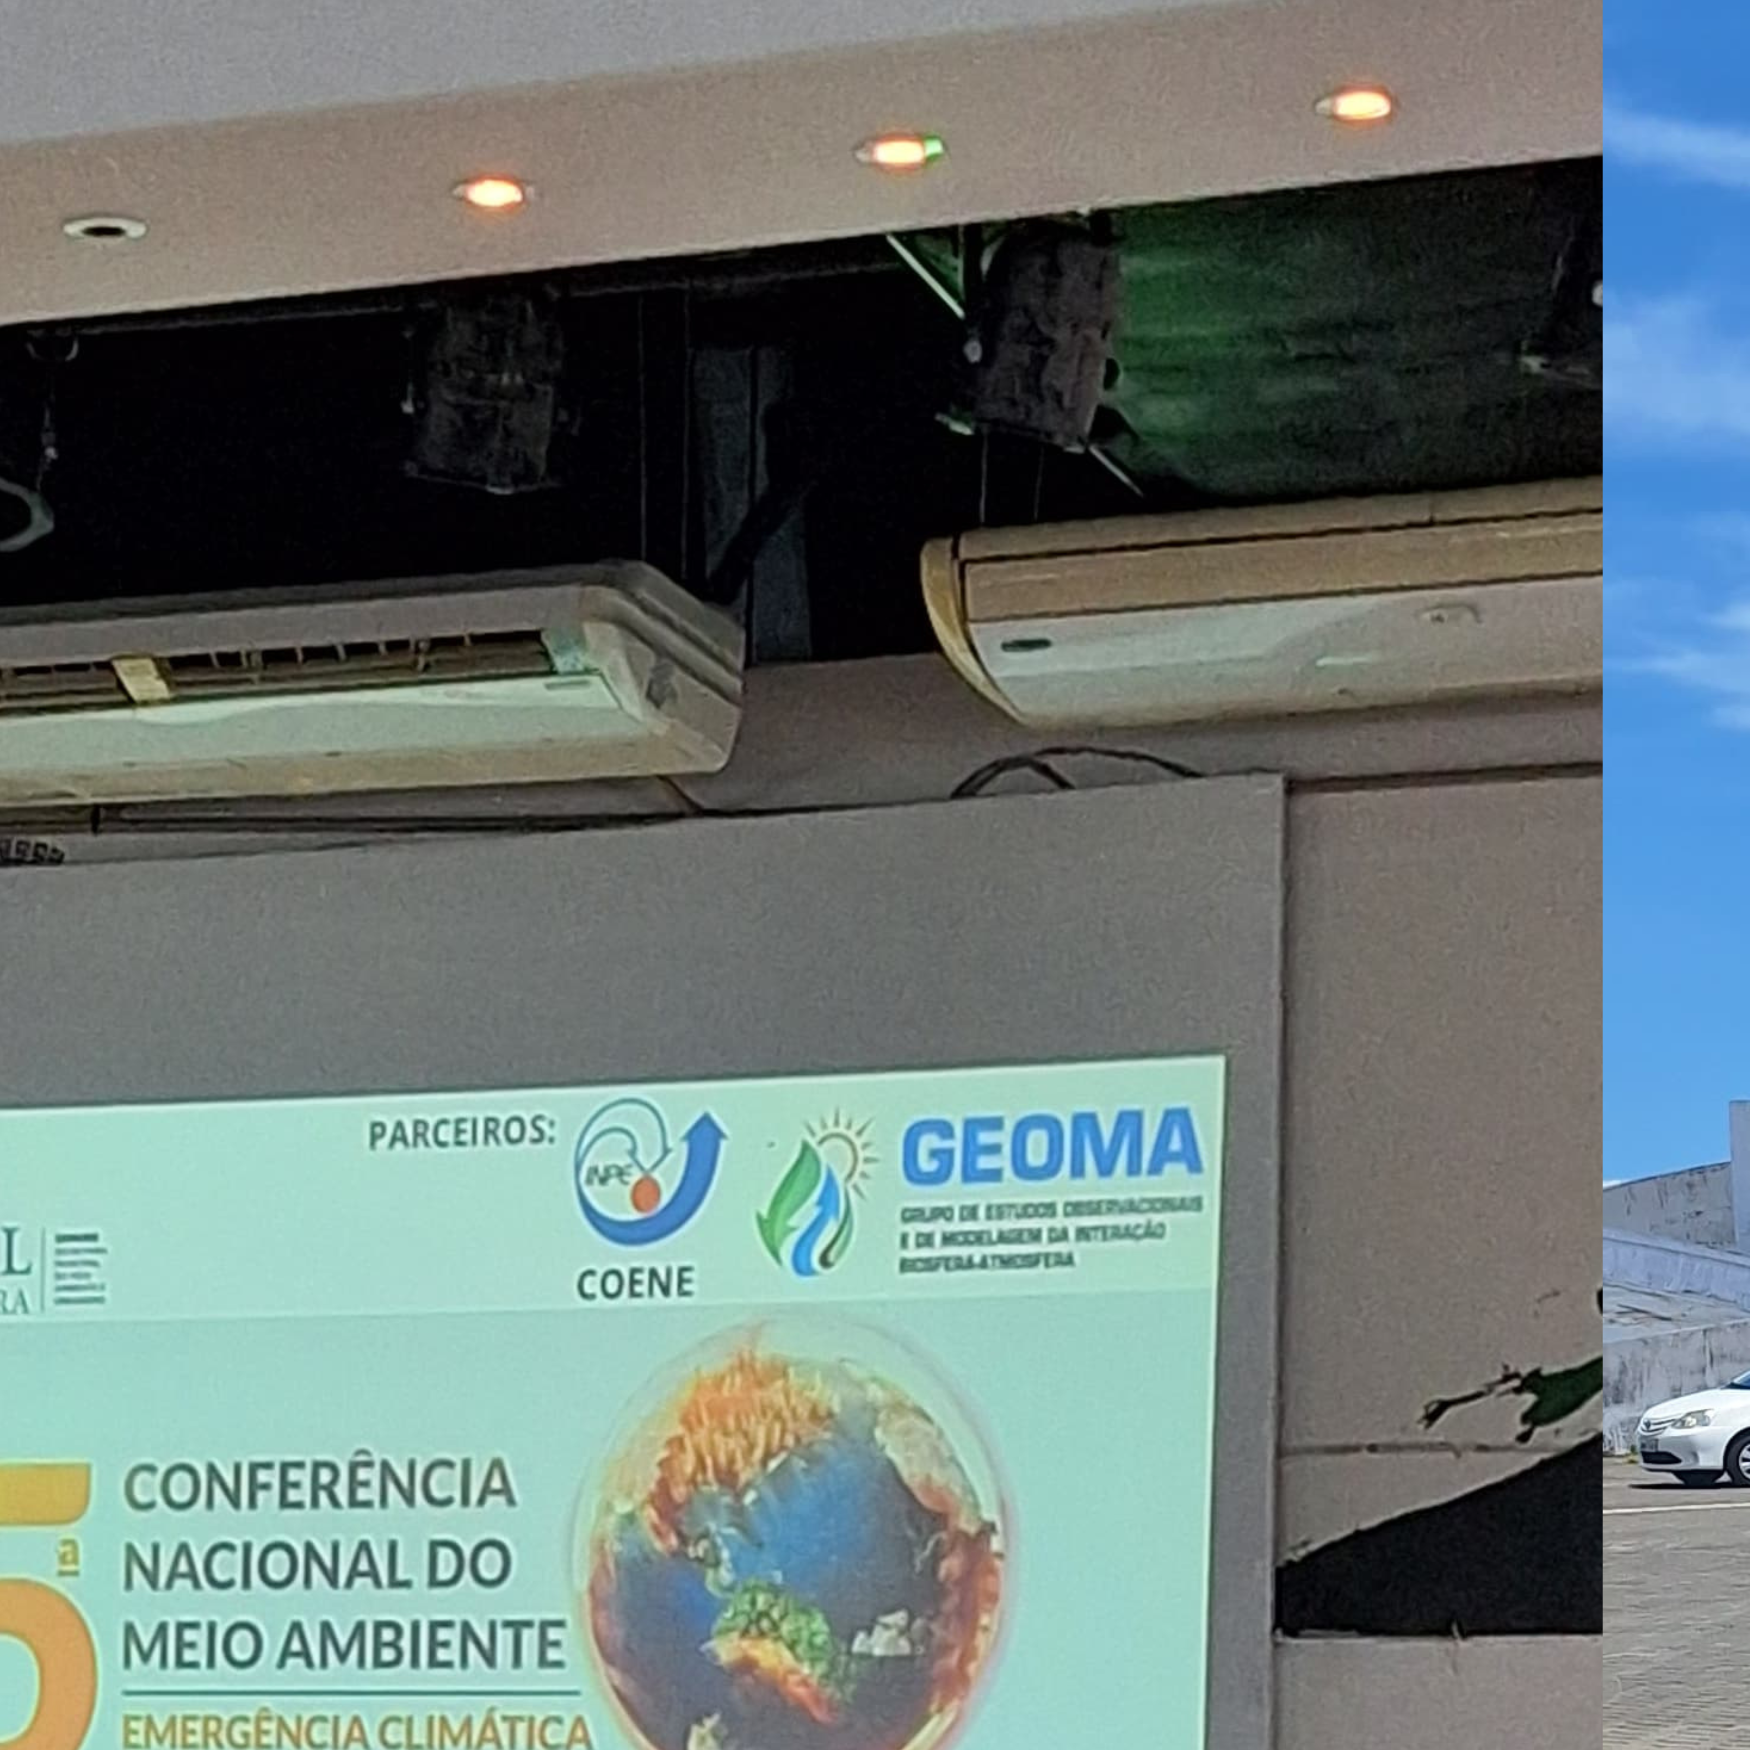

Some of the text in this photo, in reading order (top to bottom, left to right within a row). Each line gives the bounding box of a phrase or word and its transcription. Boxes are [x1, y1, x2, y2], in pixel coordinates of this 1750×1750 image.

[369, 1114, 556, 1151] PARCEIROS:
[902, 1107, 1204, 1186] GEOMA
[901, 1204, 955, 1224] GRUPO
[959, 1203, 979, 1222] DE
[577, 1265, 695, 1301] COENE
[123, 1449, 518, 1512] CONFERÊNCIA
[123, 1538, 512, 1593] NACIONAL DO
[122, 1618, 567, 1671] MEIO AMBIENTE
